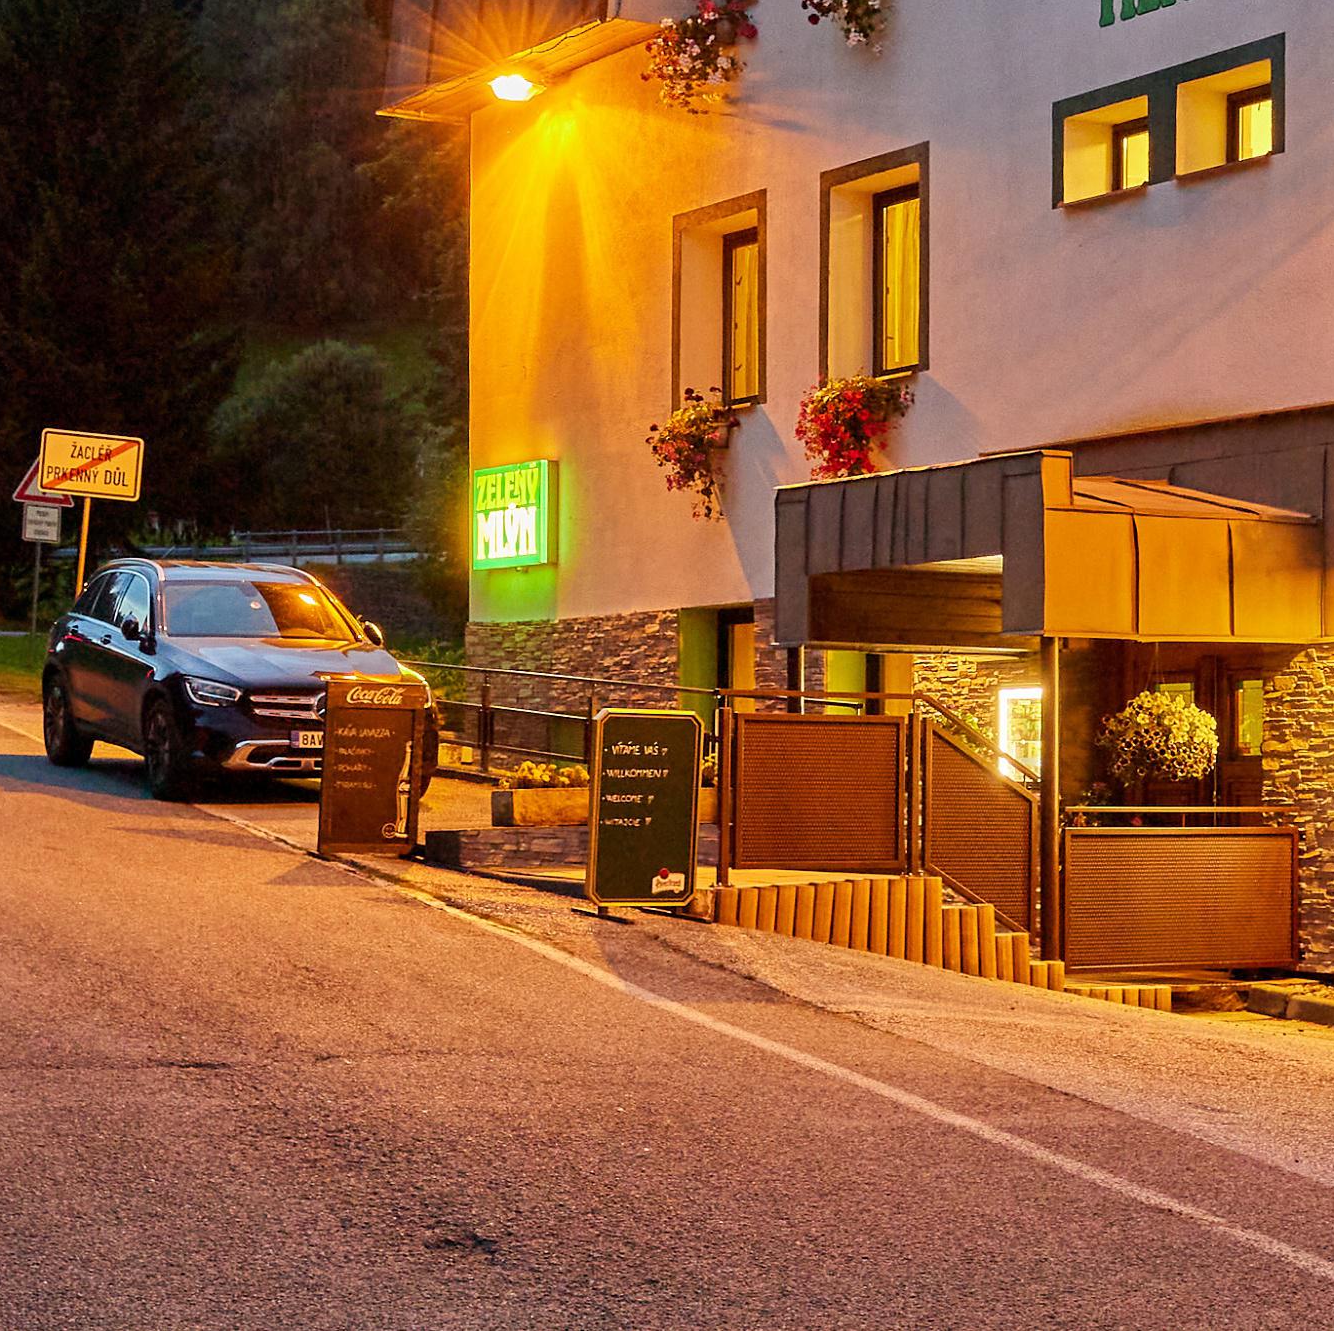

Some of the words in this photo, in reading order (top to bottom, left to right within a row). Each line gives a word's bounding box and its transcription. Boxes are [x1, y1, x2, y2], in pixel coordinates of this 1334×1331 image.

[70, 441, 113, 463] ŽACLÉŘ
[46, 465, 100, 484] PRKENNÝ
[104, 466, 130, 488] DŮL
[476, 502, 538, 560] MLÝN
[606, 768, 662, 779] WILLKOMMEN
[605, 794, 644, 804] WELCOME
